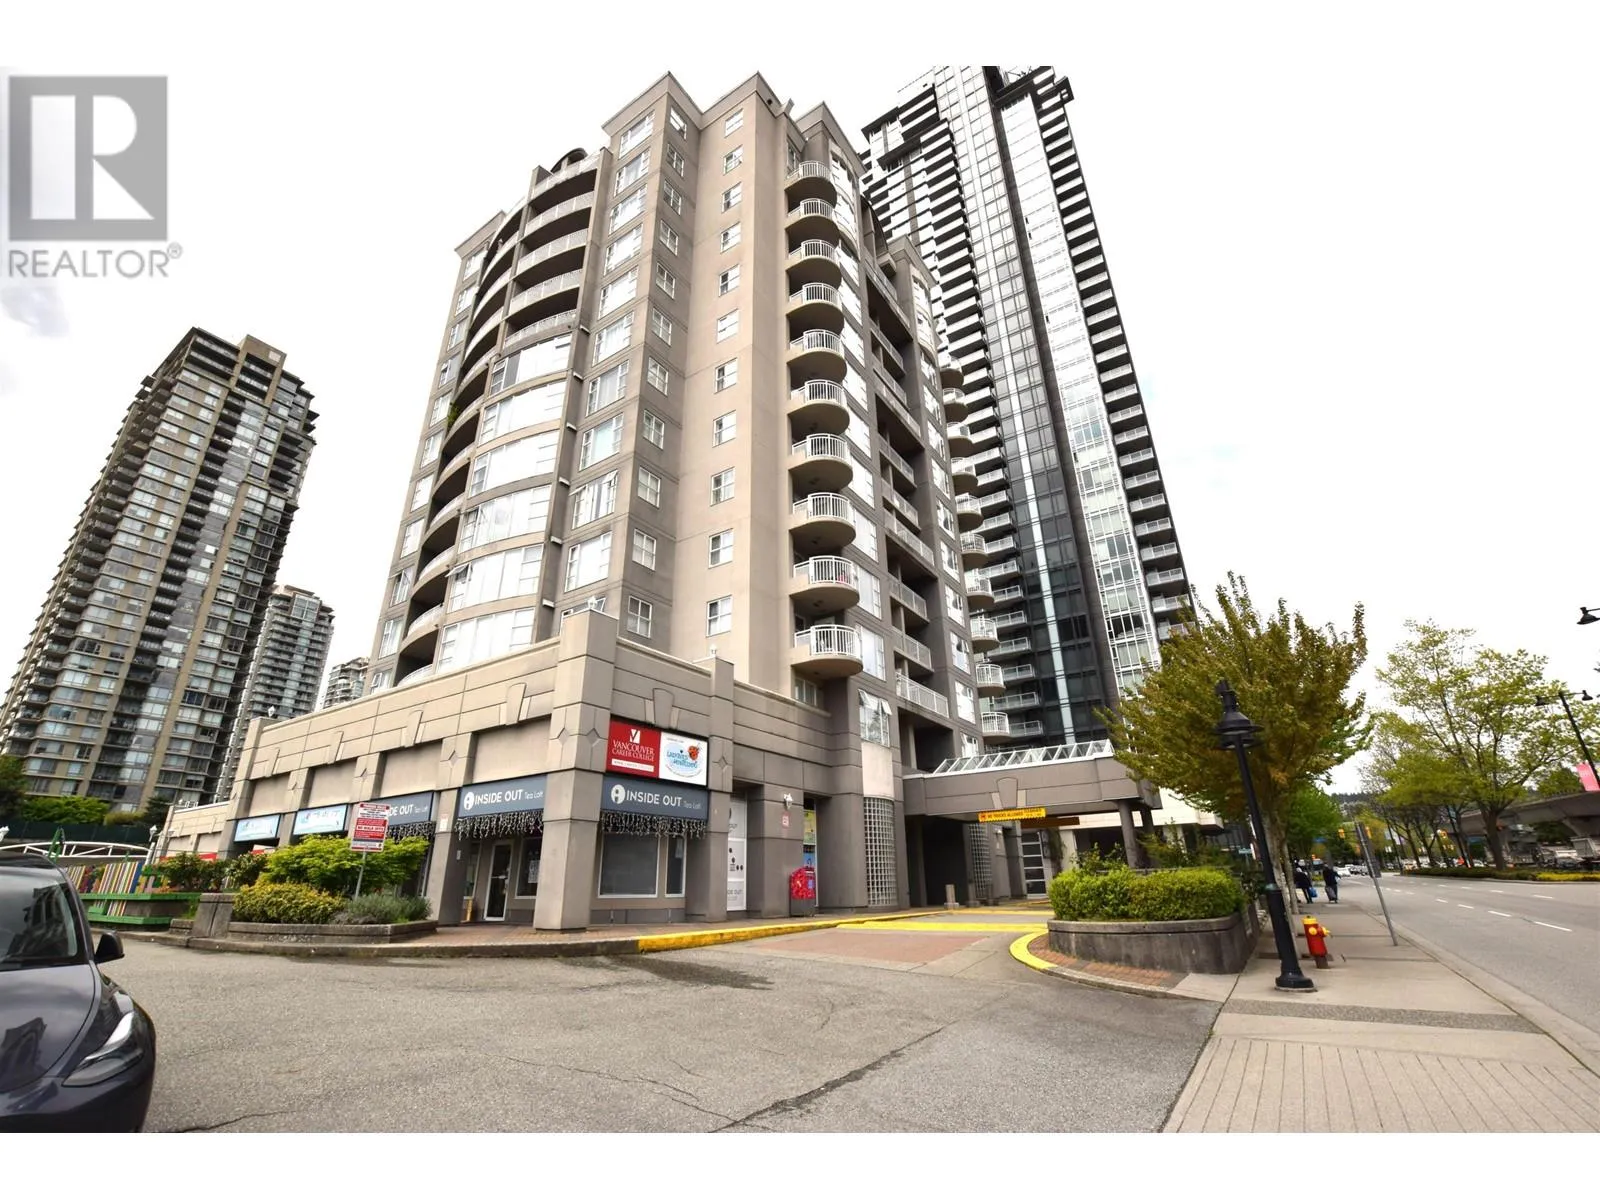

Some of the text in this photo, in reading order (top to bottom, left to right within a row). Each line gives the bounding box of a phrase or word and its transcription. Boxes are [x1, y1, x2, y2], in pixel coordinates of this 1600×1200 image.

[611, 748, 632, 758] CAREER
[633, 751, 655, 762] COLLEGE
[613, 740, 655, 755] VANCOUVER
[474, 791, 503, 805] INSIDE
[504, 789, 524, 802] OUT
[626, 789, 660, 804] INSIDE
[662, 795, 682, 807] OUT
[399, 803, 415, 815] OUT
